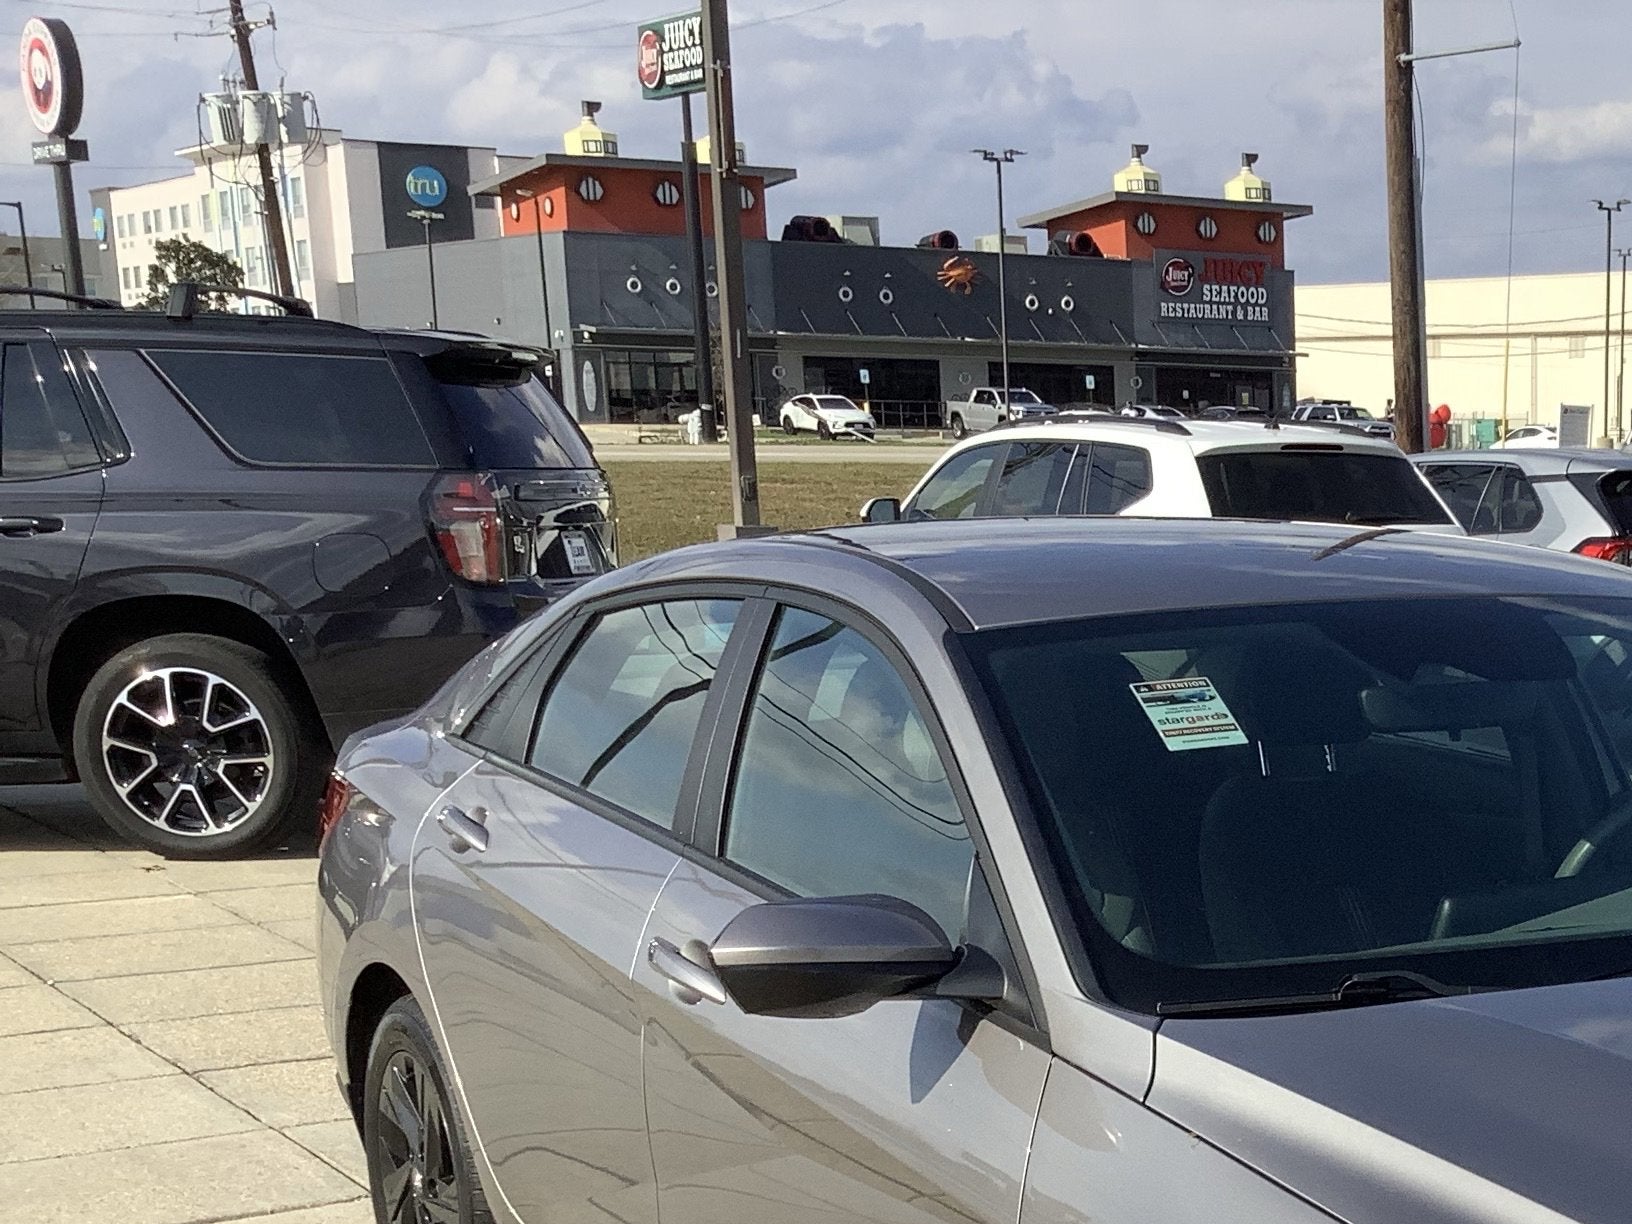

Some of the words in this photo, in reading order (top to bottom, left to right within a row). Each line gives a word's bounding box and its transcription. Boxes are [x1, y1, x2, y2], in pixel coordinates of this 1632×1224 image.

[661, 16, 701, 52] JUICY
[663, 45, 704, 72] SEAFOOD
[1198, 256, 1266, 287] JUICY
[1202, 284, 1268, 305] SEAFOOD
[1160, 302, 1234, 320] RESTAURANT
[1236, 305, 1244, 320] &
[1246, 306, 1269, 322] BAR
[1155, 680, 1207, 691] ATTENTION
